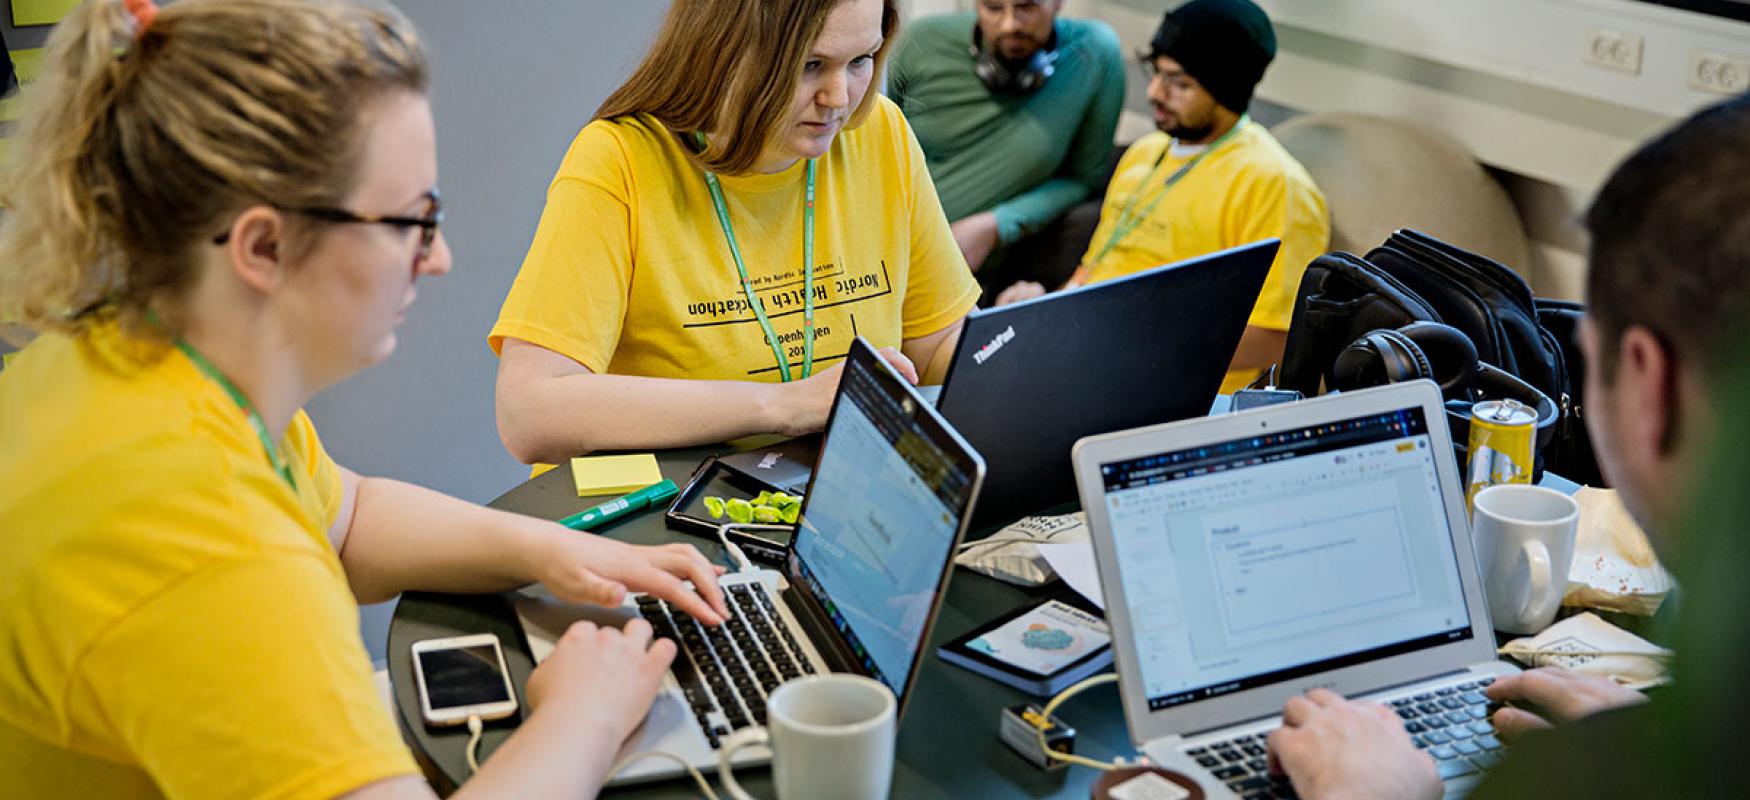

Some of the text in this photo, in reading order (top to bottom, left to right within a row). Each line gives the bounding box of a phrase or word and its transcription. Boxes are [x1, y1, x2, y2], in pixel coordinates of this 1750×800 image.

[773, 271, 795, 281] Nordic
[835, 273, 879, 295] Nordic
[688, 297, 766, 317] ckathon
[763, 326, 831, 346] Cpenhgen
[788, 345, 806, 357] 201
